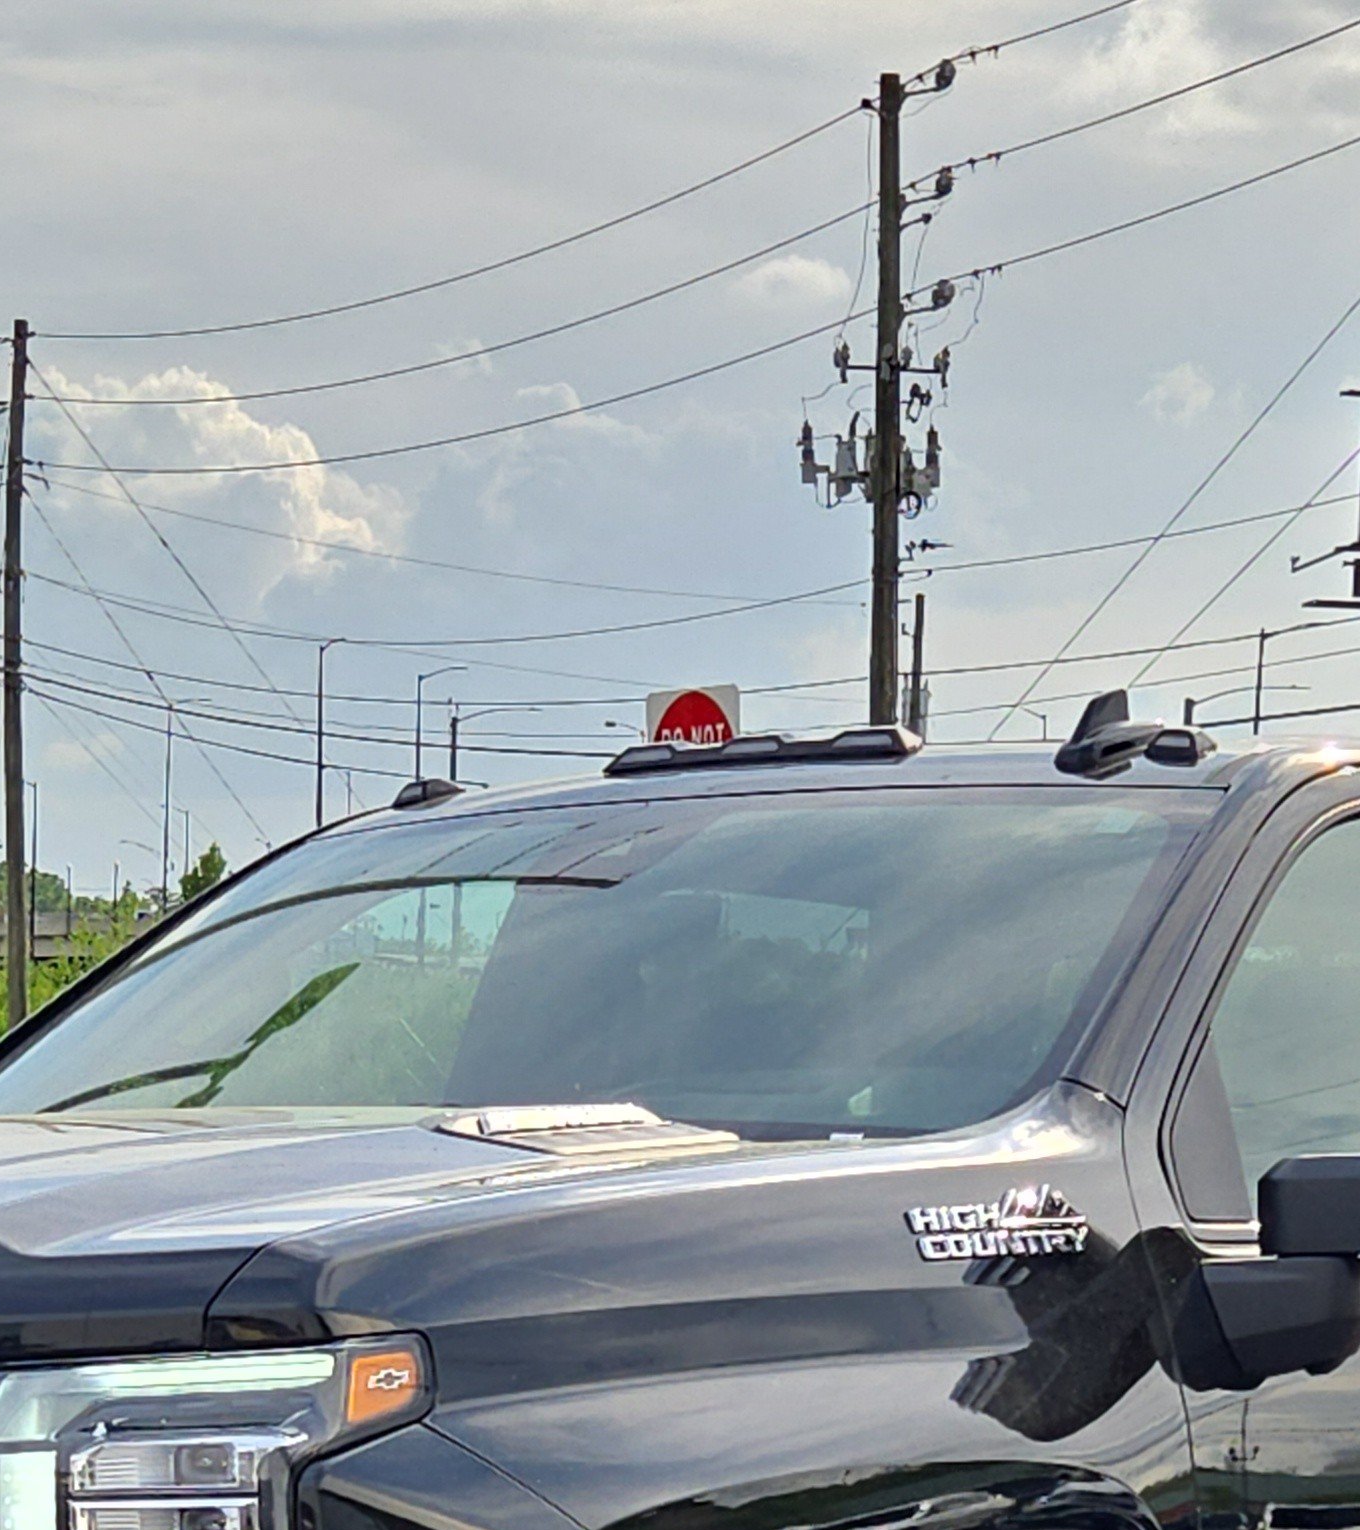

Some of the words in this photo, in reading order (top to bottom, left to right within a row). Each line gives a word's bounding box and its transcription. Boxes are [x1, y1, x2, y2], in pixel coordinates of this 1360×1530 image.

[690, 722, 726, 745] NOT
[905, 1201, 1001, 1233] HIGH
[918, 1225, 1089, 1261] COUNTRY
